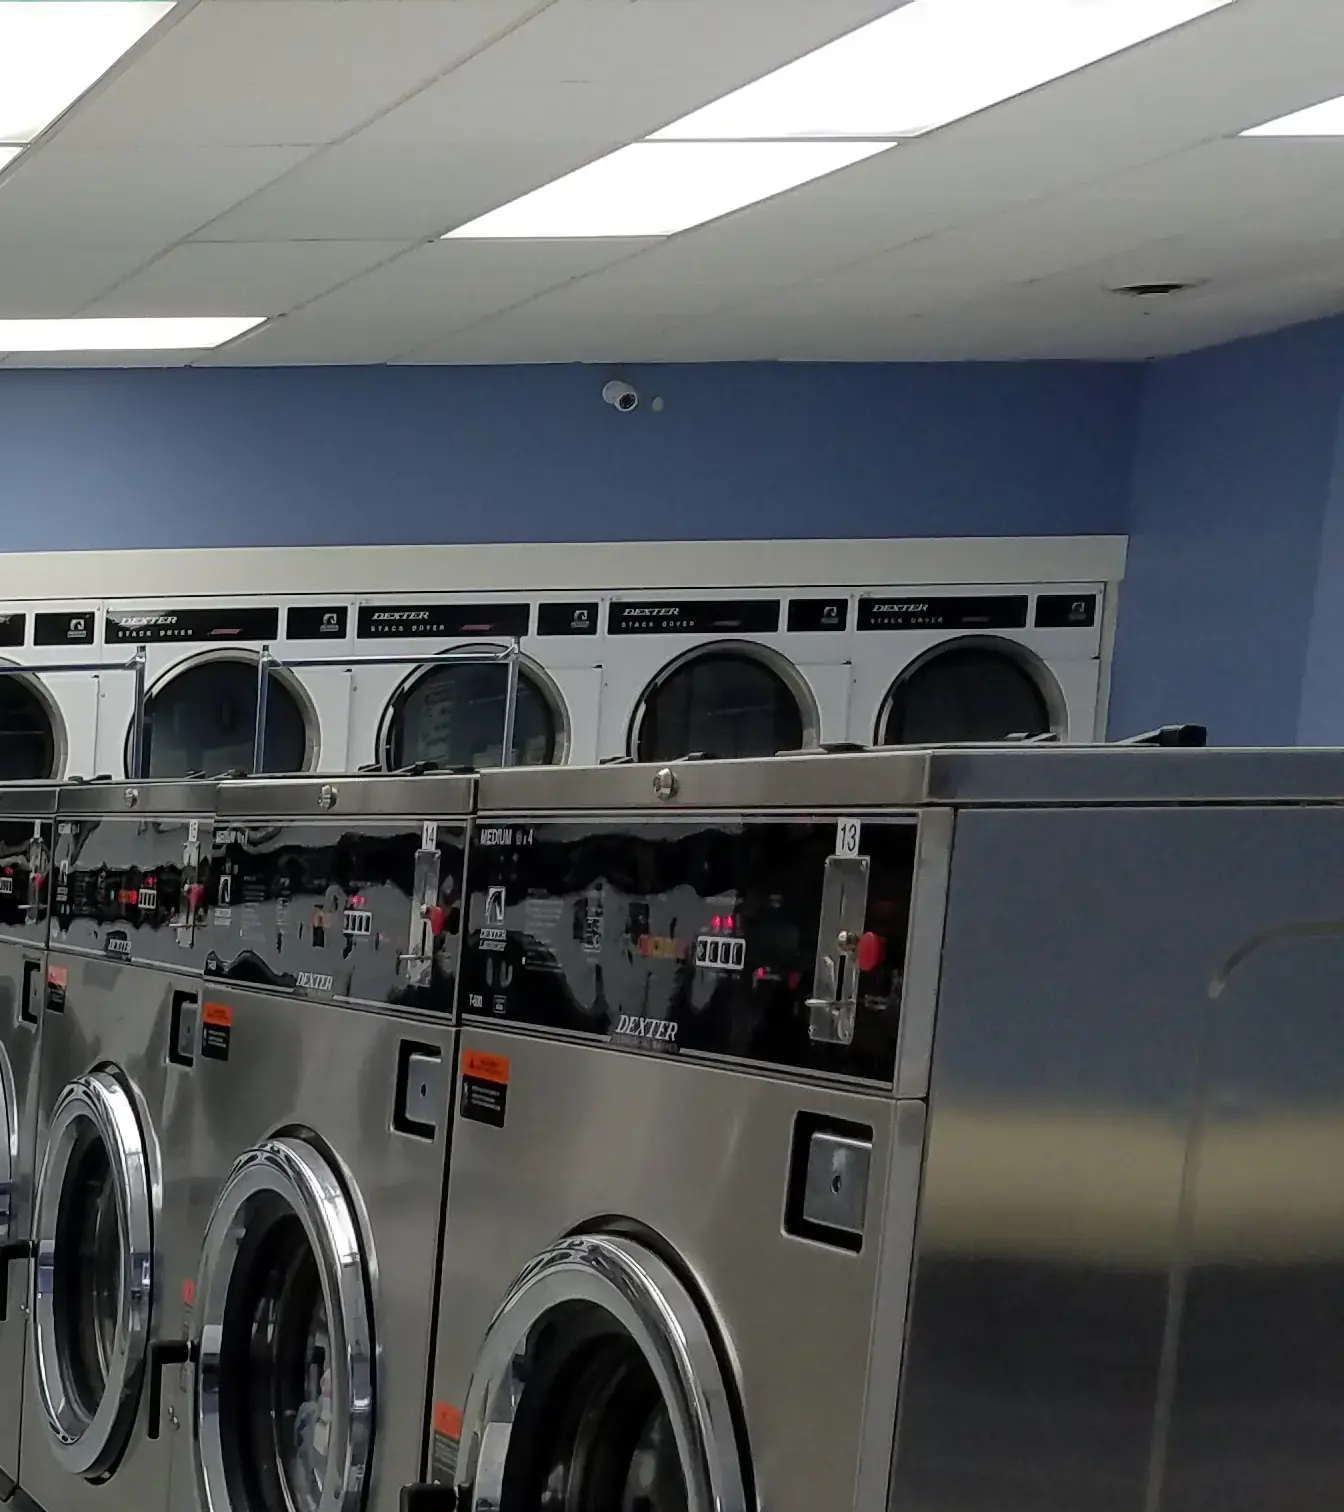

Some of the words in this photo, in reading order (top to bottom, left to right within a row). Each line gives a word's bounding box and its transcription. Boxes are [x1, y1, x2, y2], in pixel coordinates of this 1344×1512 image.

[372, 611, 429, 620] DEXTER
[622, 607, 680, 616] DEXTER
[119, 616, 177, 626] DEXTER
[424, 826, 436, 845] 14
[480, 828, 512, 845] MEDIUM
[840, 824, 857, 852] 13
[296, 971, 334, 990] DEXTER
[615, 1014, 679, 1041] DEXTER
